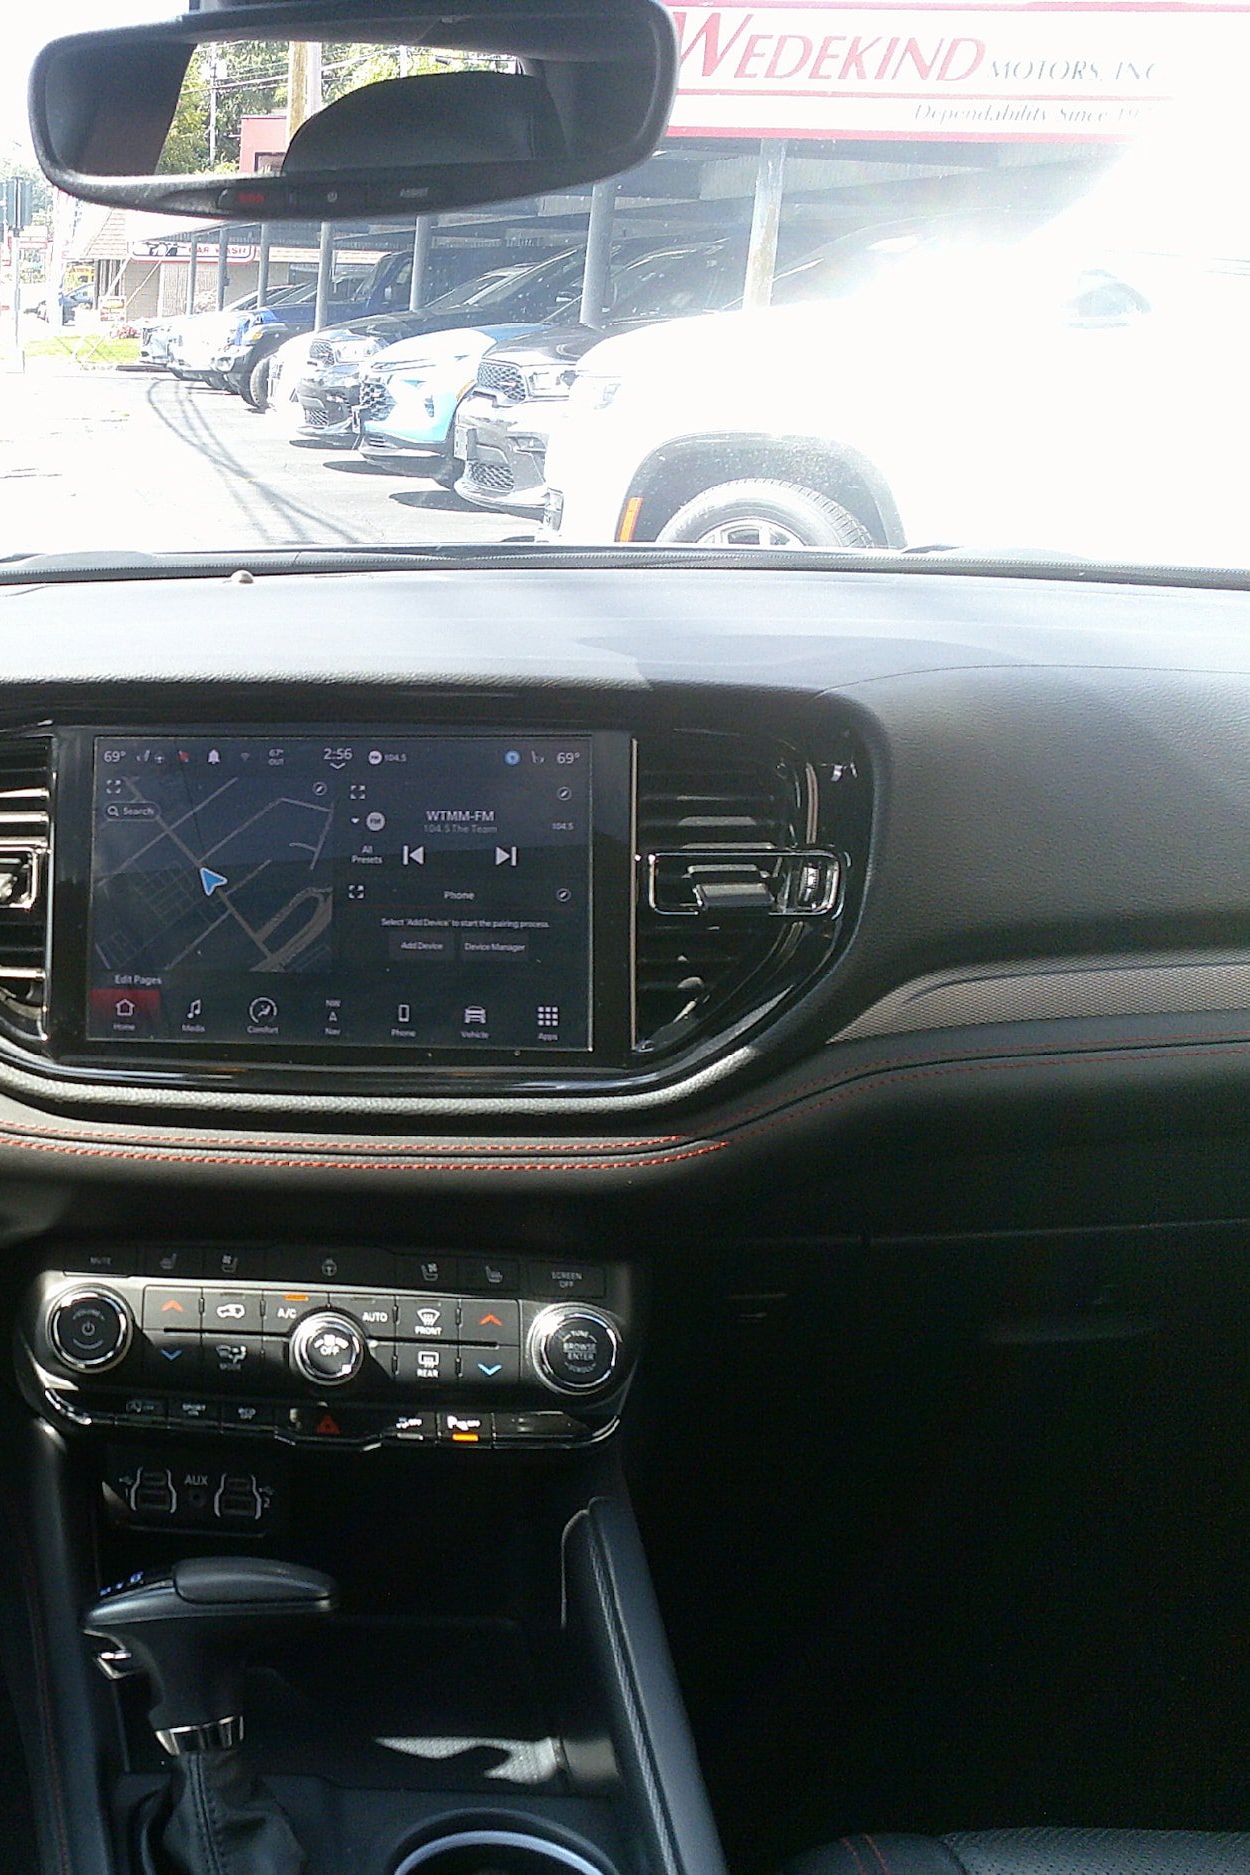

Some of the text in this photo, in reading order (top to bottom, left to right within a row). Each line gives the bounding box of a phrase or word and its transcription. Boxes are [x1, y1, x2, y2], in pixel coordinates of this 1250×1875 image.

[672, 12, 987, 82] WEDEKIND
[323, 748, 353, 760] 2:56
[122, 806, 155, 816] Search
[426, 810, 495, 822] WTMM-FM
[452, 825, 469, 833] The
[471, 825, 498, 834] Team
[351, 855, 383, 864] Presets
[443, 890, 475, 900] Phone
[381, 917, 405, 927] Select
[460, 919, 479, 927] start
[479, 919, 492, 928] the
[492, 919, 519, 929] pairing
[400, 941, 444, 951] Add Device
[464, 942, 526, 953] Device Manager
[114, 974, 163, 986] Edit Pages
[113, 1023, 136, 1032] Home
[181, 1024, 206, 1033] Media
[247, 1025, 279, 1035] Comfort
[391, 1029, 416, 1038] Phone
[460, 1030, 490, 1039] Vehicle
[538, 1032, 558, 1041] Apps
[551, 1271, 583, 1281] SCREEN
[277, 1307, 297, 1320] A/C
[362, 1312, 388, 1323] AUTO
[414, 1326, 442, 1336] FRONT
[319, 1346, 340, 1356] OFF
[416, 1368, 439, 1379] REAR
[184, 1474, 209, 1486] AUX
